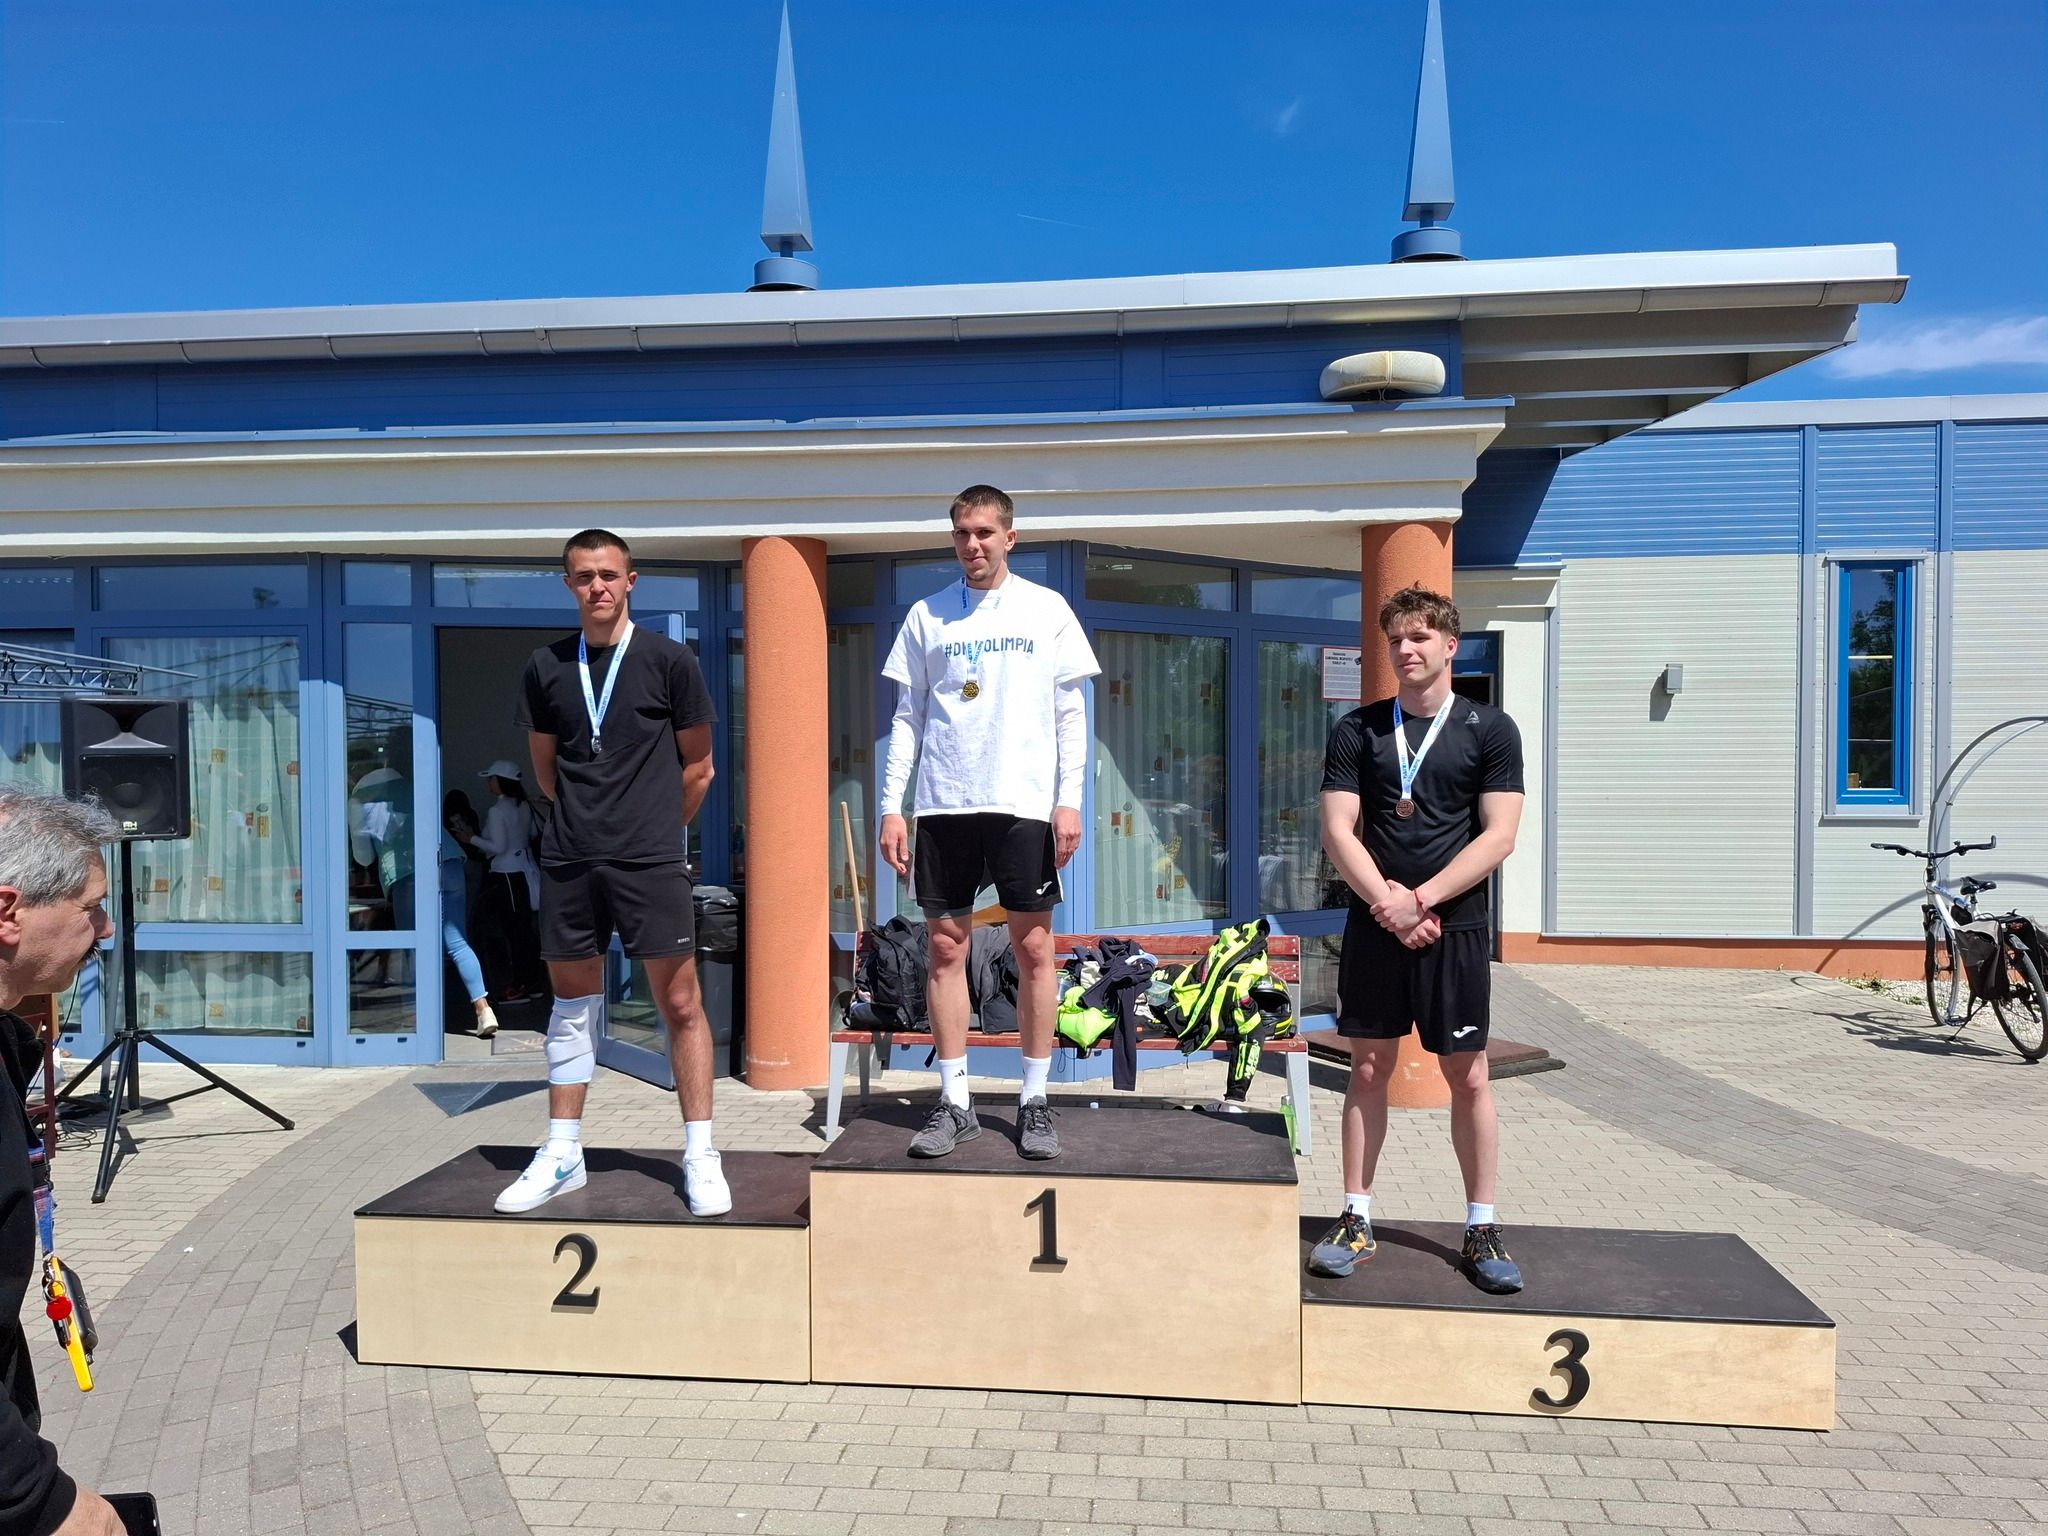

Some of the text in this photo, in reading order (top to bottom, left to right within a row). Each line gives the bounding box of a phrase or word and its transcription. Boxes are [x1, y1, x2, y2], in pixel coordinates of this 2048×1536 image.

[945, 637, 1034, 657] #DIOLIMPIA
[1026, 1188, 1068, 1265] 1
[552, 1233, 600, 1308] 2
[1530, 1328, 1590, 1408] 3
